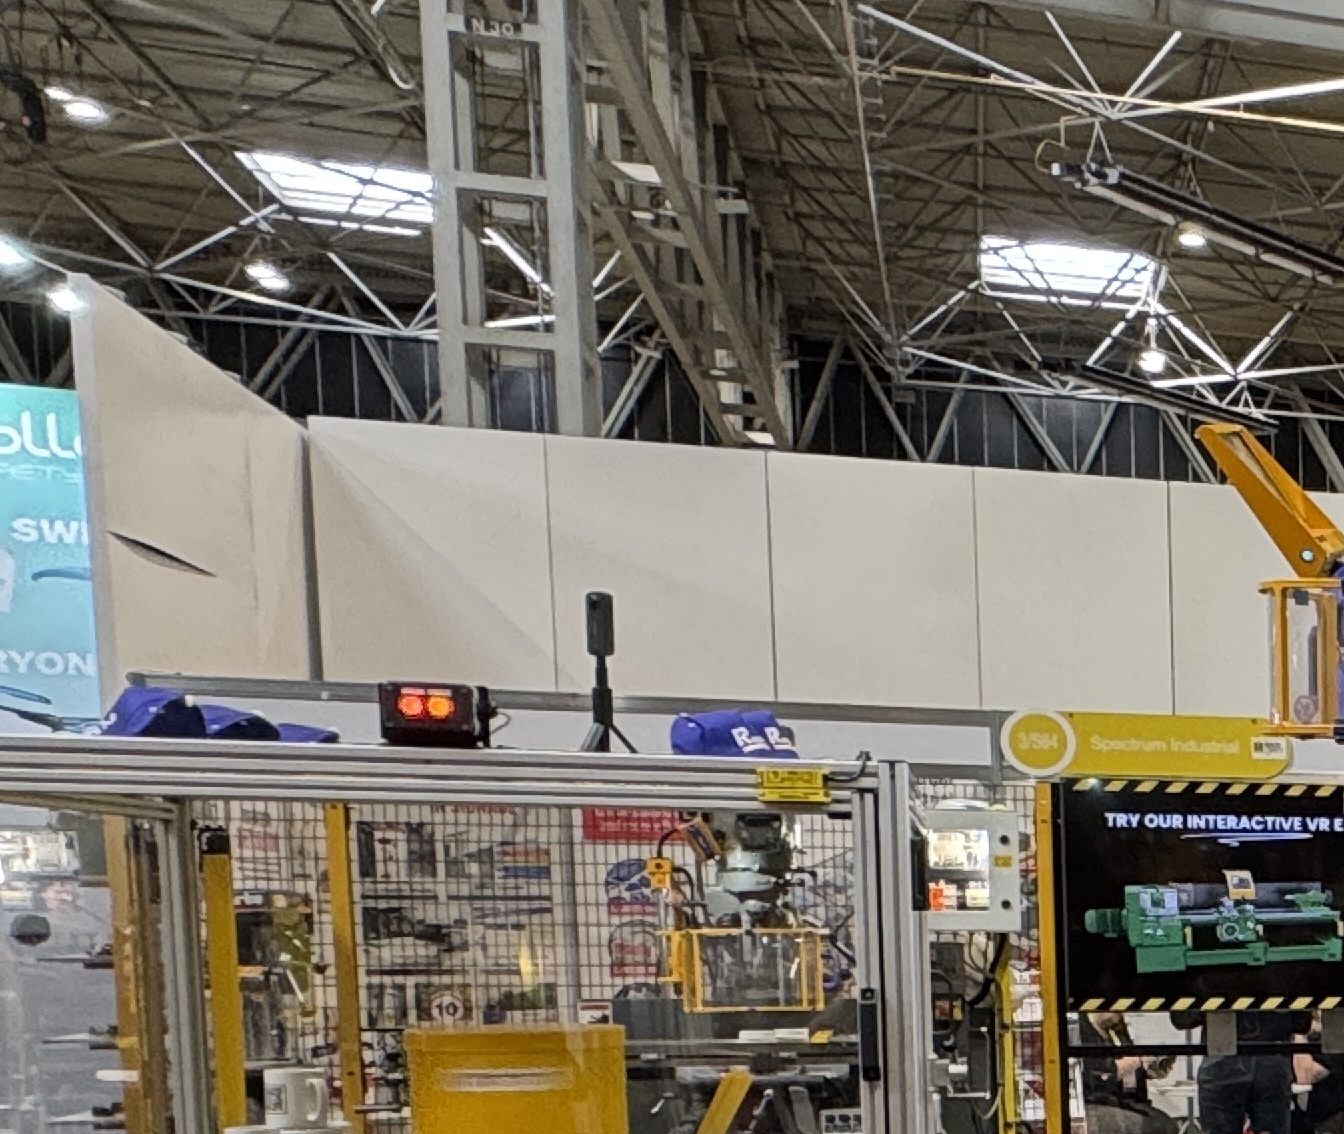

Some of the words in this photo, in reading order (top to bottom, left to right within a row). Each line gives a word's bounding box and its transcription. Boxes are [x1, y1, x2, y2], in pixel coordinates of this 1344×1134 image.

[1090, 734, 1166, 754] Spectrum
[1170, 736, 1240, 755] Industrial
[1104, 812, 1139, 829] TRY
[1144, 813, 1183, 829] OUR
[1186, 814, 1303, 831] INTERACTIVE
[1305, 817, 1331, 832] VR
